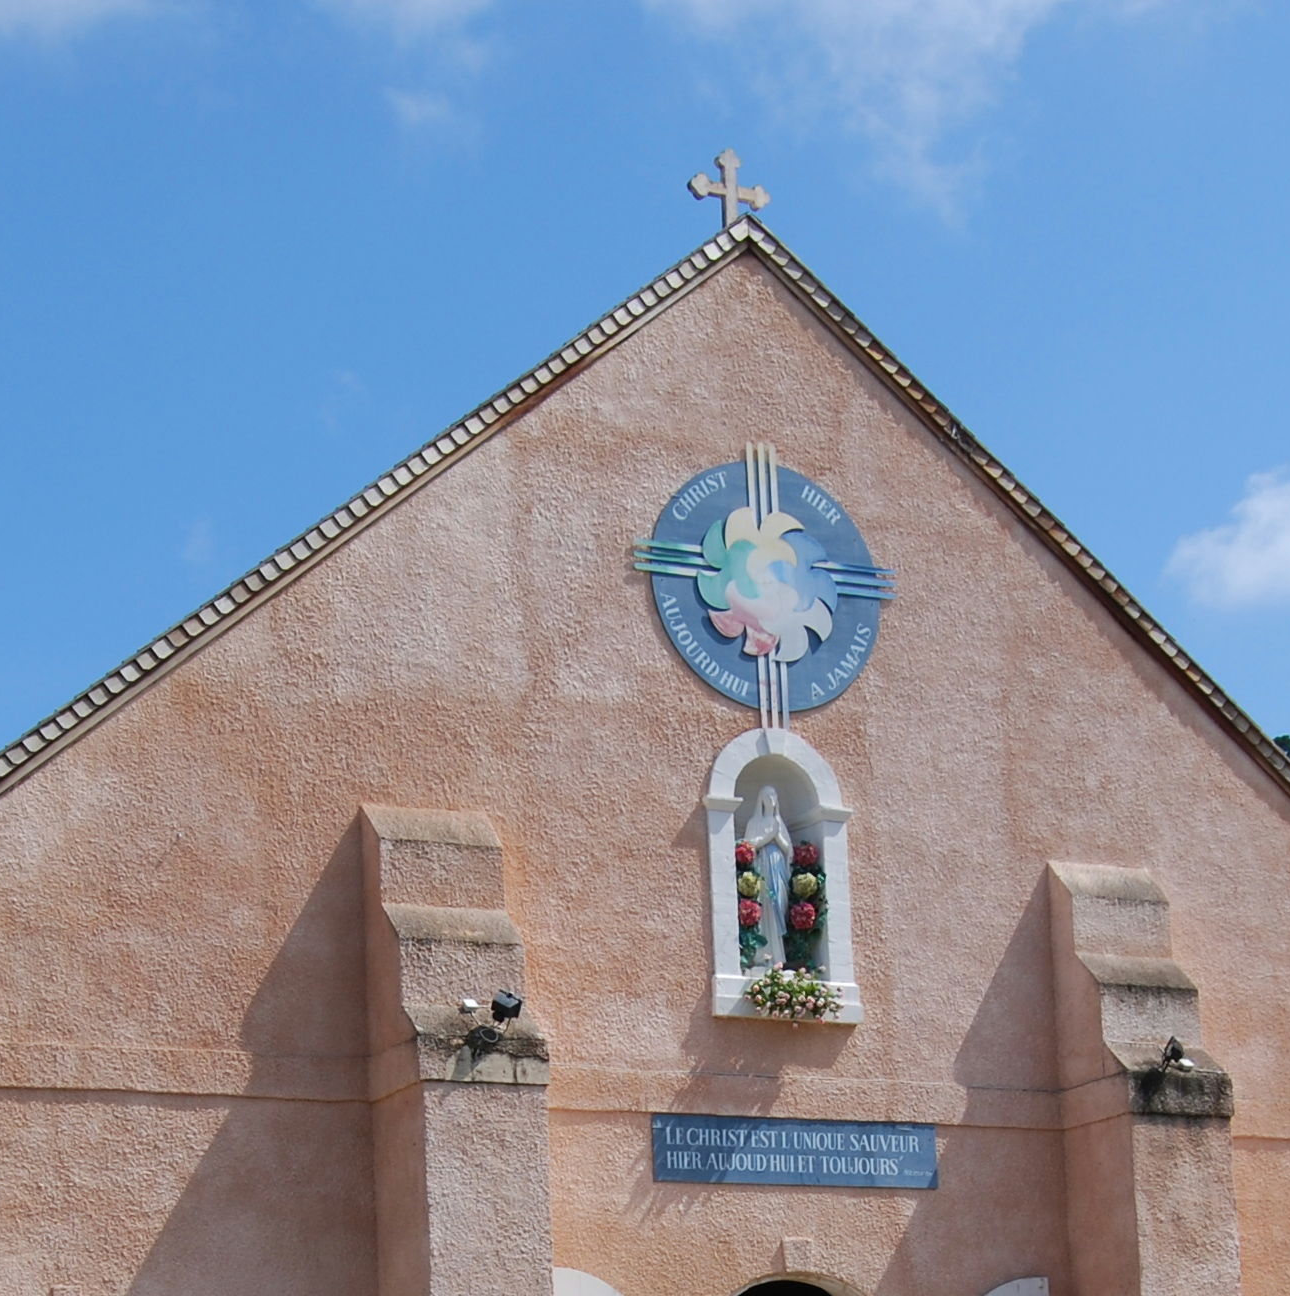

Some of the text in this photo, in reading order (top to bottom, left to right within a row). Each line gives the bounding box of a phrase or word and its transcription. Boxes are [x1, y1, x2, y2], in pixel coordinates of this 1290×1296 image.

[671, 470, 727, 521] CHRIST
[800, 484, 841, 526] HIER
[660, 591, 750, 697] AUJOURD'HUI
[827, 623, 872, 690] JAMAIS
[667, 1150, 704, 1170] HIER
[797, 1154, 816, 1174] ET
[686, 1127, 747, 1148] CHRIST
[751, 1129, 778, 1149] EST
[849, 1133, 920, 1153] SAUVEUR
